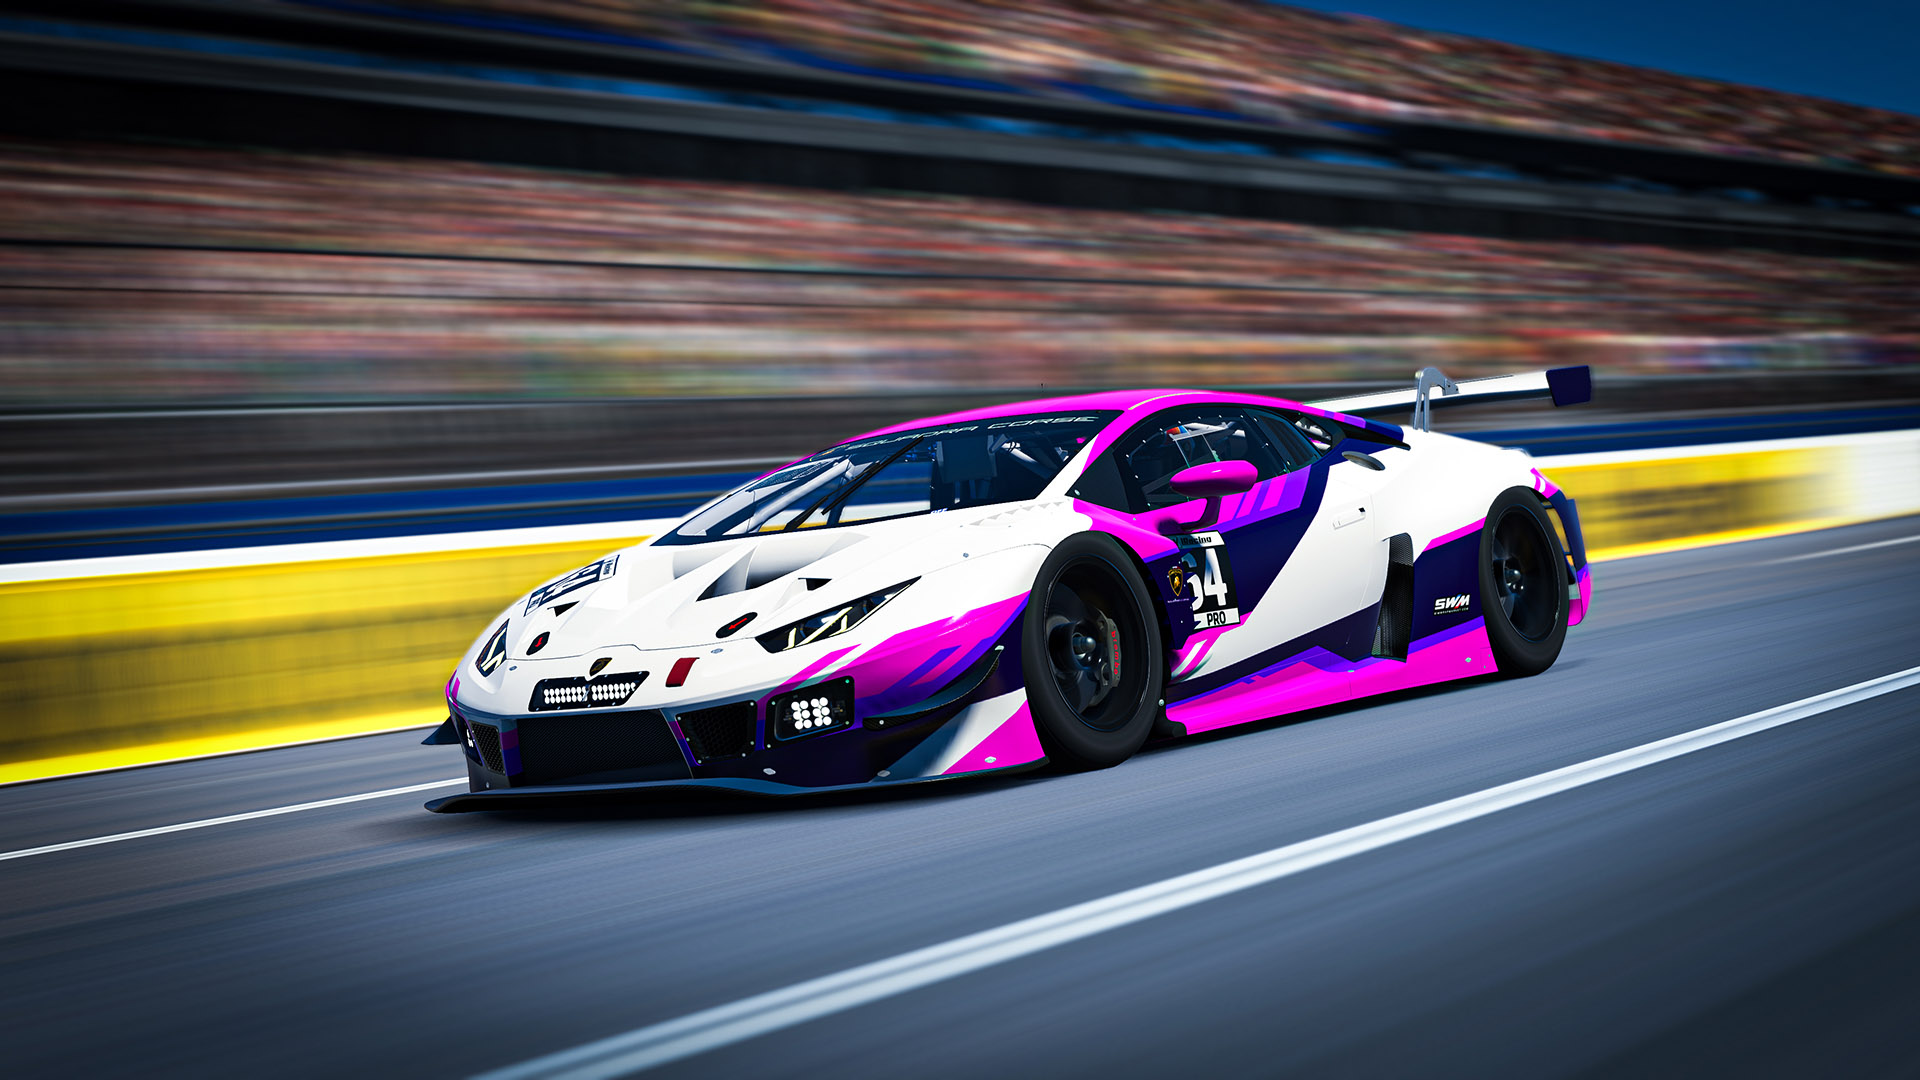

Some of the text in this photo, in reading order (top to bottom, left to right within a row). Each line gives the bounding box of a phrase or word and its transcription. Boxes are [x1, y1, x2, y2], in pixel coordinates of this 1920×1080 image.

[987, 416, 1099, 430] CORSE
[1434, 594, 1470, 610] SWM
[1206, 611, 1227, 627] PRO
